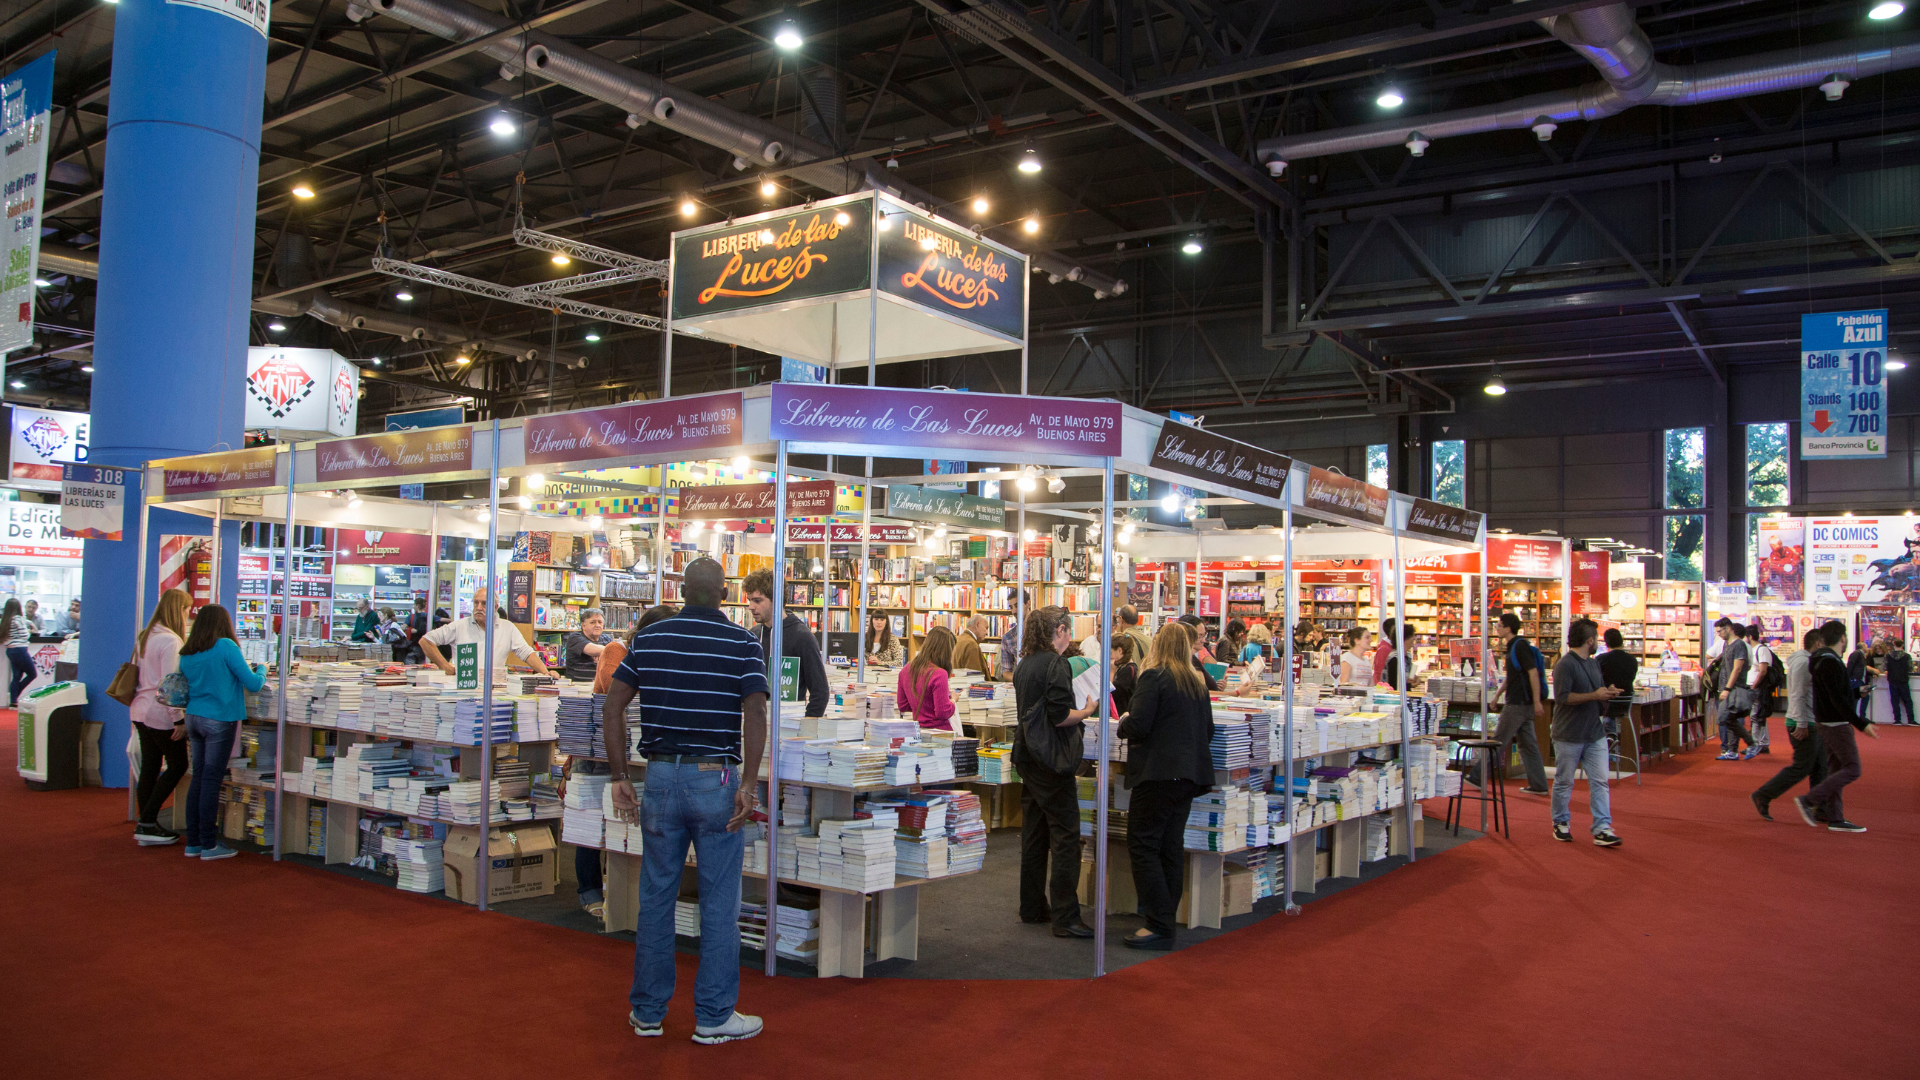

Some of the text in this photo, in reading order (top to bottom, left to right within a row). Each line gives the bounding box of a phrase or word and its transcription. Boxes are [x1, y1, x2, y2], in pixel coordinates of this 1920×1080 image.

[775, 219, 801, 250] de
[804, 213, 844, 243] las
[962, 246, 982, 272] de
[982, 252, 1009, 283] las
[698, 245, 828, 304] Luces
[901, 252, 999, 309] Luces
[1837, 314, 1882, 326] Pabellón
[1843, 324, 1883, 343] Azul
[1808, 351, 1882, 386] Calle 10
[1808, 391, 1880, 411] Stands 100
[721, 408, 736, 420] 979
[780, 399, 1026, 438] Librería de Las Luces
[1093, 417, 1114, 429] 979
[1848, 413, 1880, 433] 700
[529, 417, 675, 454] Librería de Las Luces
[457, 438, 469, 449] 979
[320, 443, 424, 473] Librería de Las Luces
[1195, 449, 1209, 469] de
[1207, 449, 1228, 474] Las
[1227, 455, 1255, 481] Luces
[94, 468, 123, 484] 308
[65, 486, 116, 499] LIBRERÍAS DE
[819, 490, 830, 498] 979
[64, 498, 105, 509] LAS LUCES
[682, 495, 718, 511] Librería
[719, 496, 729, 509] de
[732, 493, 753, 509] Las
[923, 499, 933, 513] de
[934, 498, 951, 515] Las
[953, 500, 975, 518] Luces
[8, 523, 33, 538] De
[1779, 521, 1803, 530] MARVEL
[789, 528, 822, 540] Librería
[834, 528, 853, 540] Las
[1813, 527, 1879, 541] DC COMICS
[0, 546, 70, 557] Libros Revistas
[461, 645, 473, 654] c/u
[460, 658, 474, 667] $80
[781, 658, 791, 669] /u
[458, 680, 476, 688] $200
